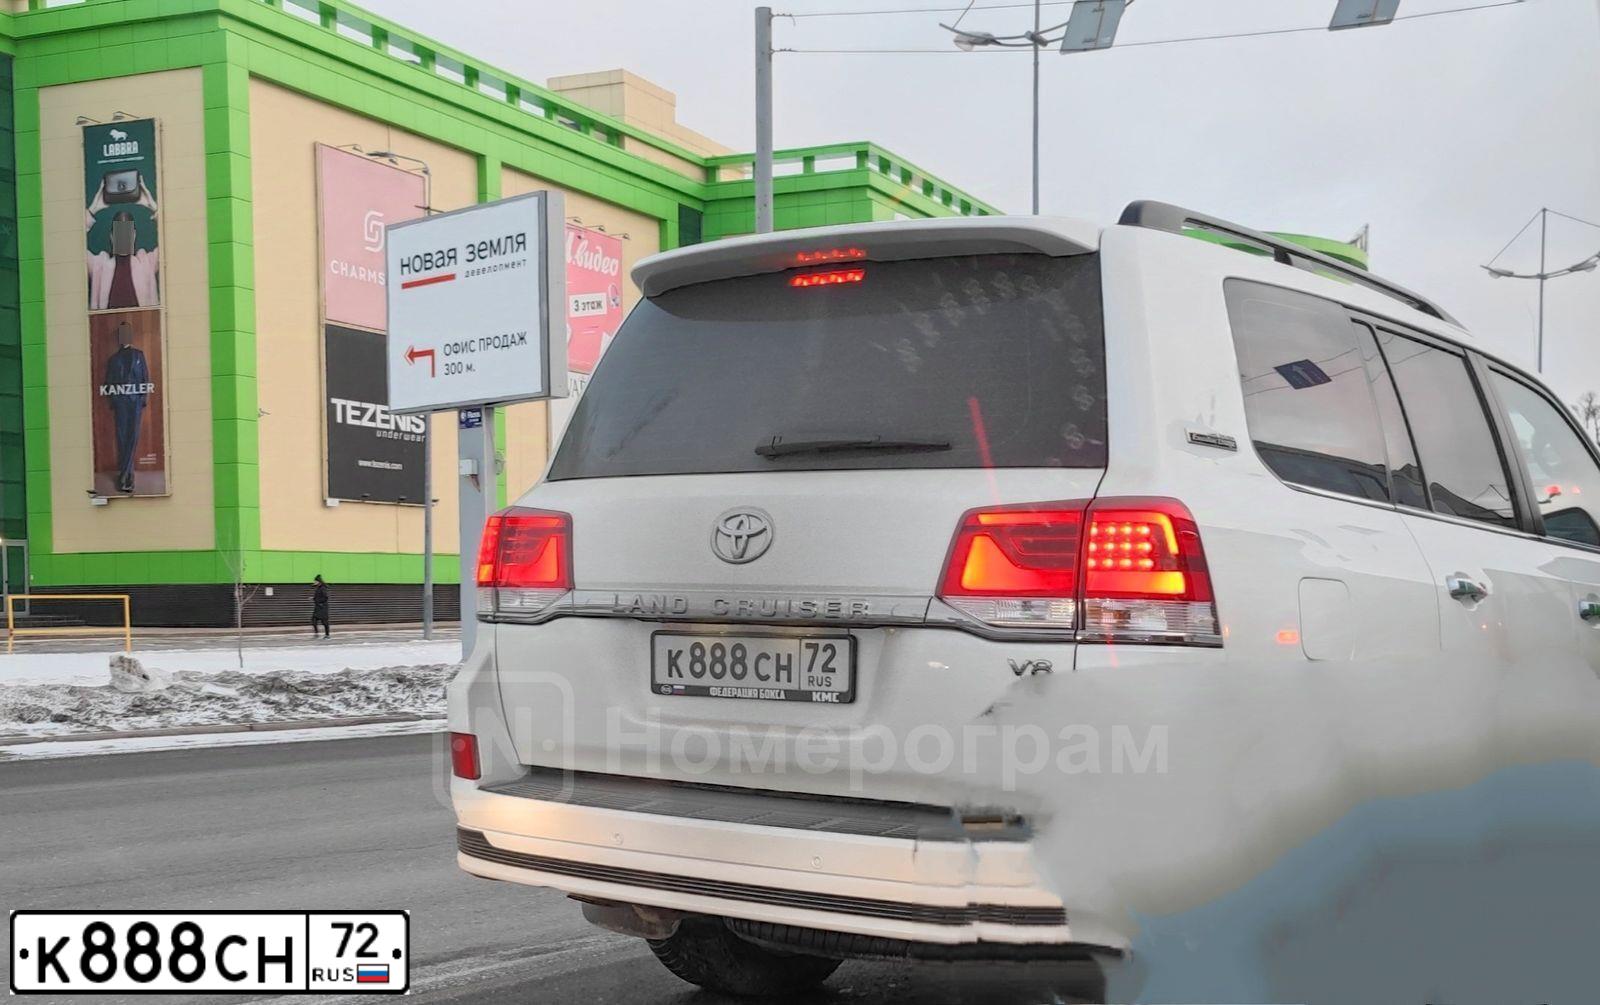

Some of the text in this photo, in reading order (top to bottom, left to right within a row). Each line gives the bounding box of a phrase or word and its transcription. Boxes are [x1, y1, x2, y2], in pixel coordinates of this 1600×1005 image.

[103, 141, 139, 157] LABBRA
[400, 232, 527, 276] новая земля
[330, 259, 386, 286] CHARMS
[574, 299, 603, 312] 3 этаж
[443, 331, 528, 357] ОФИС ПРОДАЖ
[444, 361, 464, 376] 300
[99, 382, 155, 397] KANZLER
[330, 397, 426, 434] TEZENIS
[376, 430, 426, 442] underwear
[612, 593, 870, 619] LAND CRUISER
[804, 642, 837, 673] 72
[807, 675, 832, 687] RUS
[709, 686, 786, 700] ФЕДЕРАЦИЯ БОКСА
